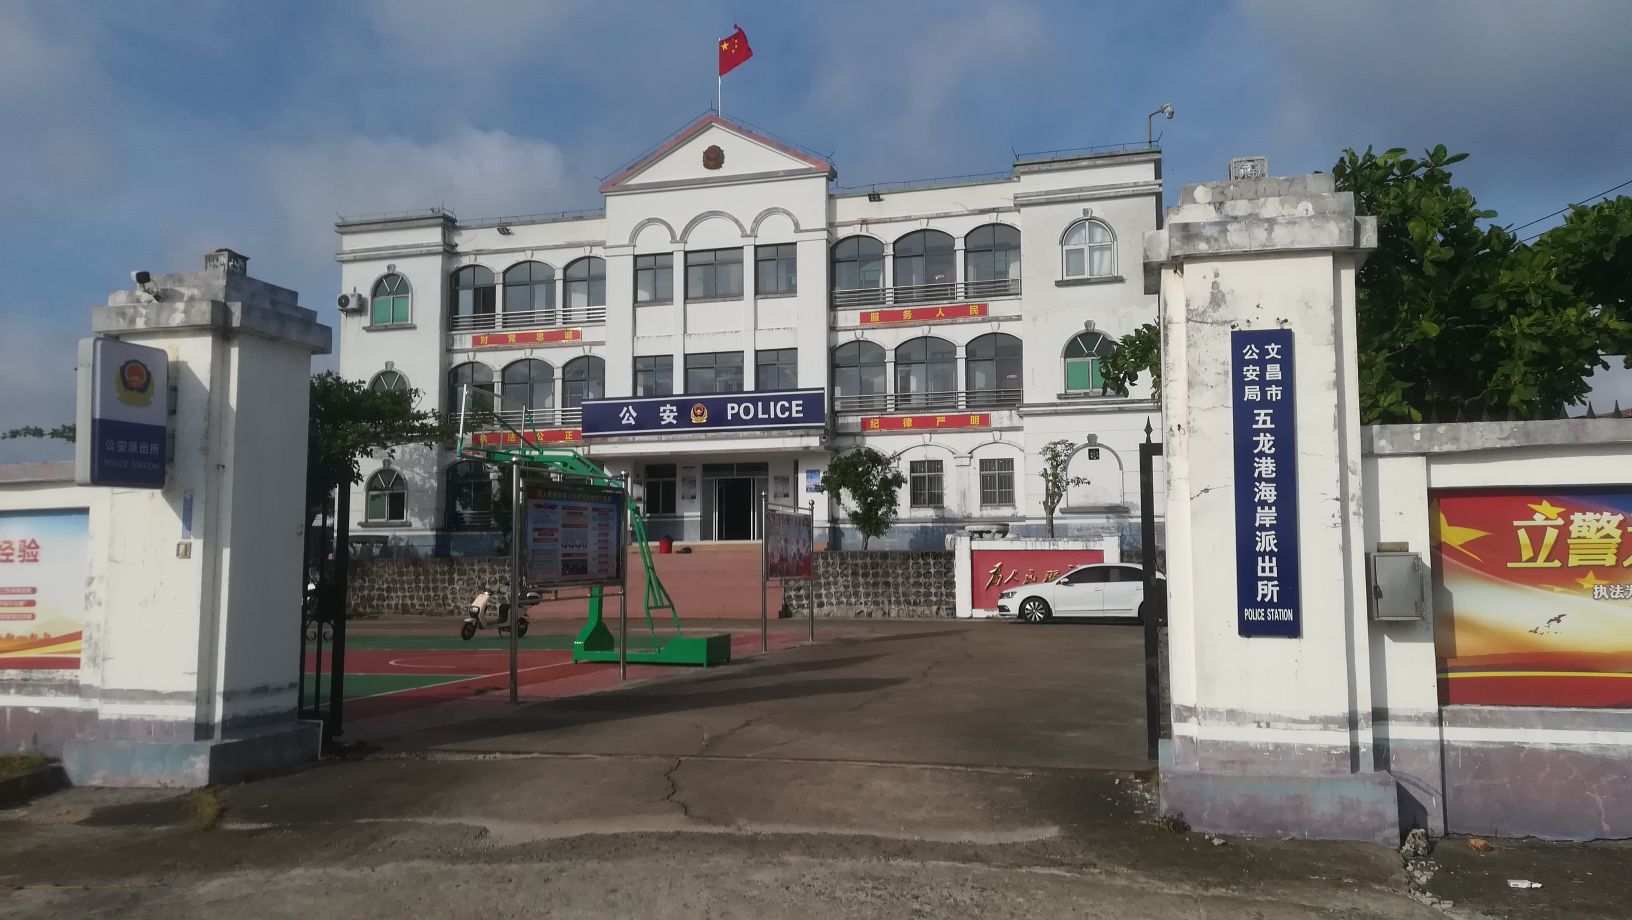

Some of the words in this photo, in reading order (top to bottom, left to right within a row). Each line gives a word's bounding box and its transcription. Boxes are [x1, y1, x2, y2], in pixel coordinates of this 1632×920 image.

[870, 305, 979, 322] 服务人民
[1243, 344, 1261, 401] 公安局
[1265, 343, 1282, 401] 文昌市
[619, 405, 678, 426] 公安
[727, 400, 804, 420] POLICE
[870, 416, 980, 429] 纪律严明
[104, 439, 160, 455] 公安派出所
[1252, 409, 1280, 603] 五龙港海岸派出所
[1507, 511, 1632, 568] 立警
[1245, 608, 1265, 620] POLICE
[1267, 608, 1293, 620] STATION
